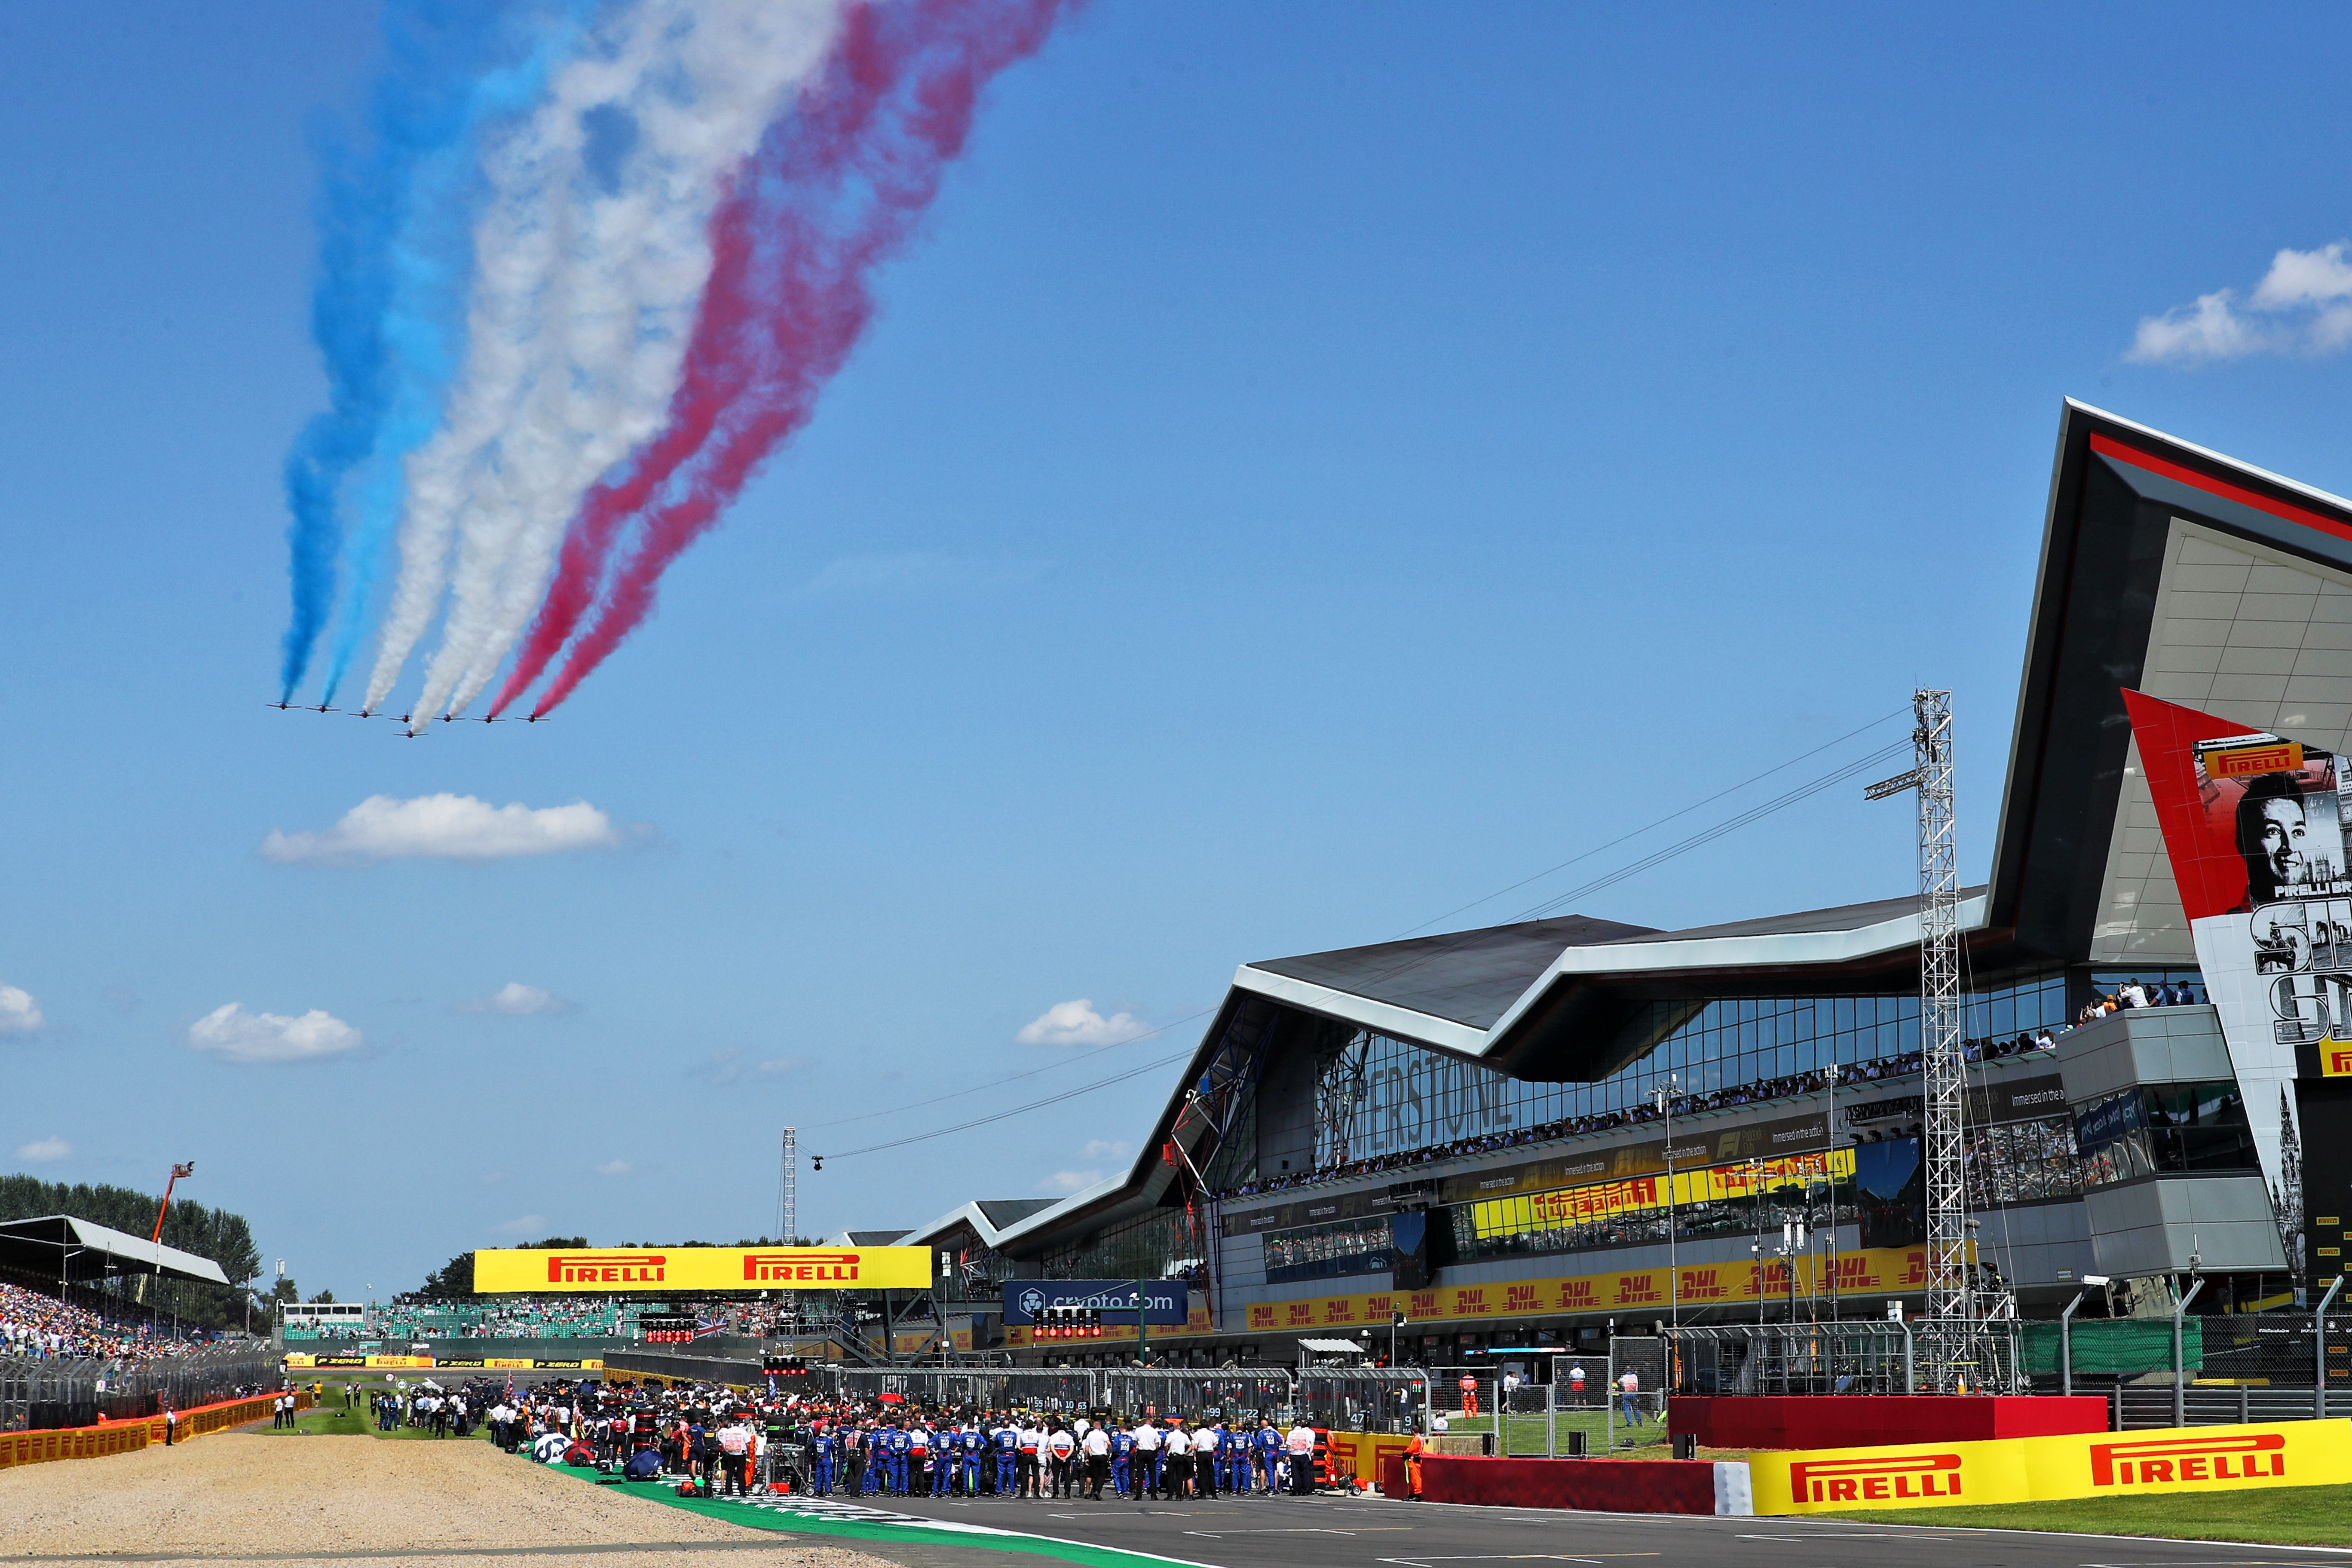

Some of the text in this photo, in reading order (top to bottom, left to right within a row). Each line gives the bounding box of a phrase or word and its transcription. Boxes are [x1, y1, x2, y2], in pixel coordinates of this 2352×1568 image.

[2217, 748, 2290, 774] PIRELLI
[2274, 882, 2330, 897] PIRELLI
[1314, 1054, 1512, 1163] SILVERSTONE
[2012, 1093, 2041, 1107] Immersed
[2042, 1092, 2049, 1102] in
[2049, 1089, 2060, 1101] the
[1772, 1128, 1795, 1143] Immersed
[1795, 1129, 1800, 1139] in
[1800, 1127, 1808, 1139] the
[1694, 1144, 1707, 1155] action
[548, 1256, 666, 1282] PIRELLI
[744, 1254, 860, 1280] PIRELLI
[1828, 1257, 1871, 1290] DHL
[1620, 1275, 1656, 1303] DHL
[1681, 1270, 1721, 1299] DHL
[1751, 1265, 1796, 1295] DHL
[1411, 1293, 1439, 1317] DHL
[1456, 1289, 1485, 1314] DHL
[1507, 1286, 1538, 1311] DHL
[1561, 1281, 1594, 1308] DHL
[1254, 1307, 1275, 1327] DHL
[1289, 1304, 1312, 1325] DHL
[1327, 1300, 1351, 1323] DHL
[1367, 1297, 1394, 1320] DHL
[1065, 1400, 1074, 1409] 10
[1078, 1402, 1087, 1410] 63
[1133, 1405, 1138, 1413] 7
[1209, 1408, 1221, 1418] 99
[1247, 1409, 1259, 1418] 22
[1307, 1412, 1314, 1421] 6
[1350, 1413, 1365, 1424] 47
[1405, 1416, 1412, 1426] 9
[2090, 1434, 2285, 1486] PIRELLI
[1790, 1454, 1962, 1503] PIRELLI
